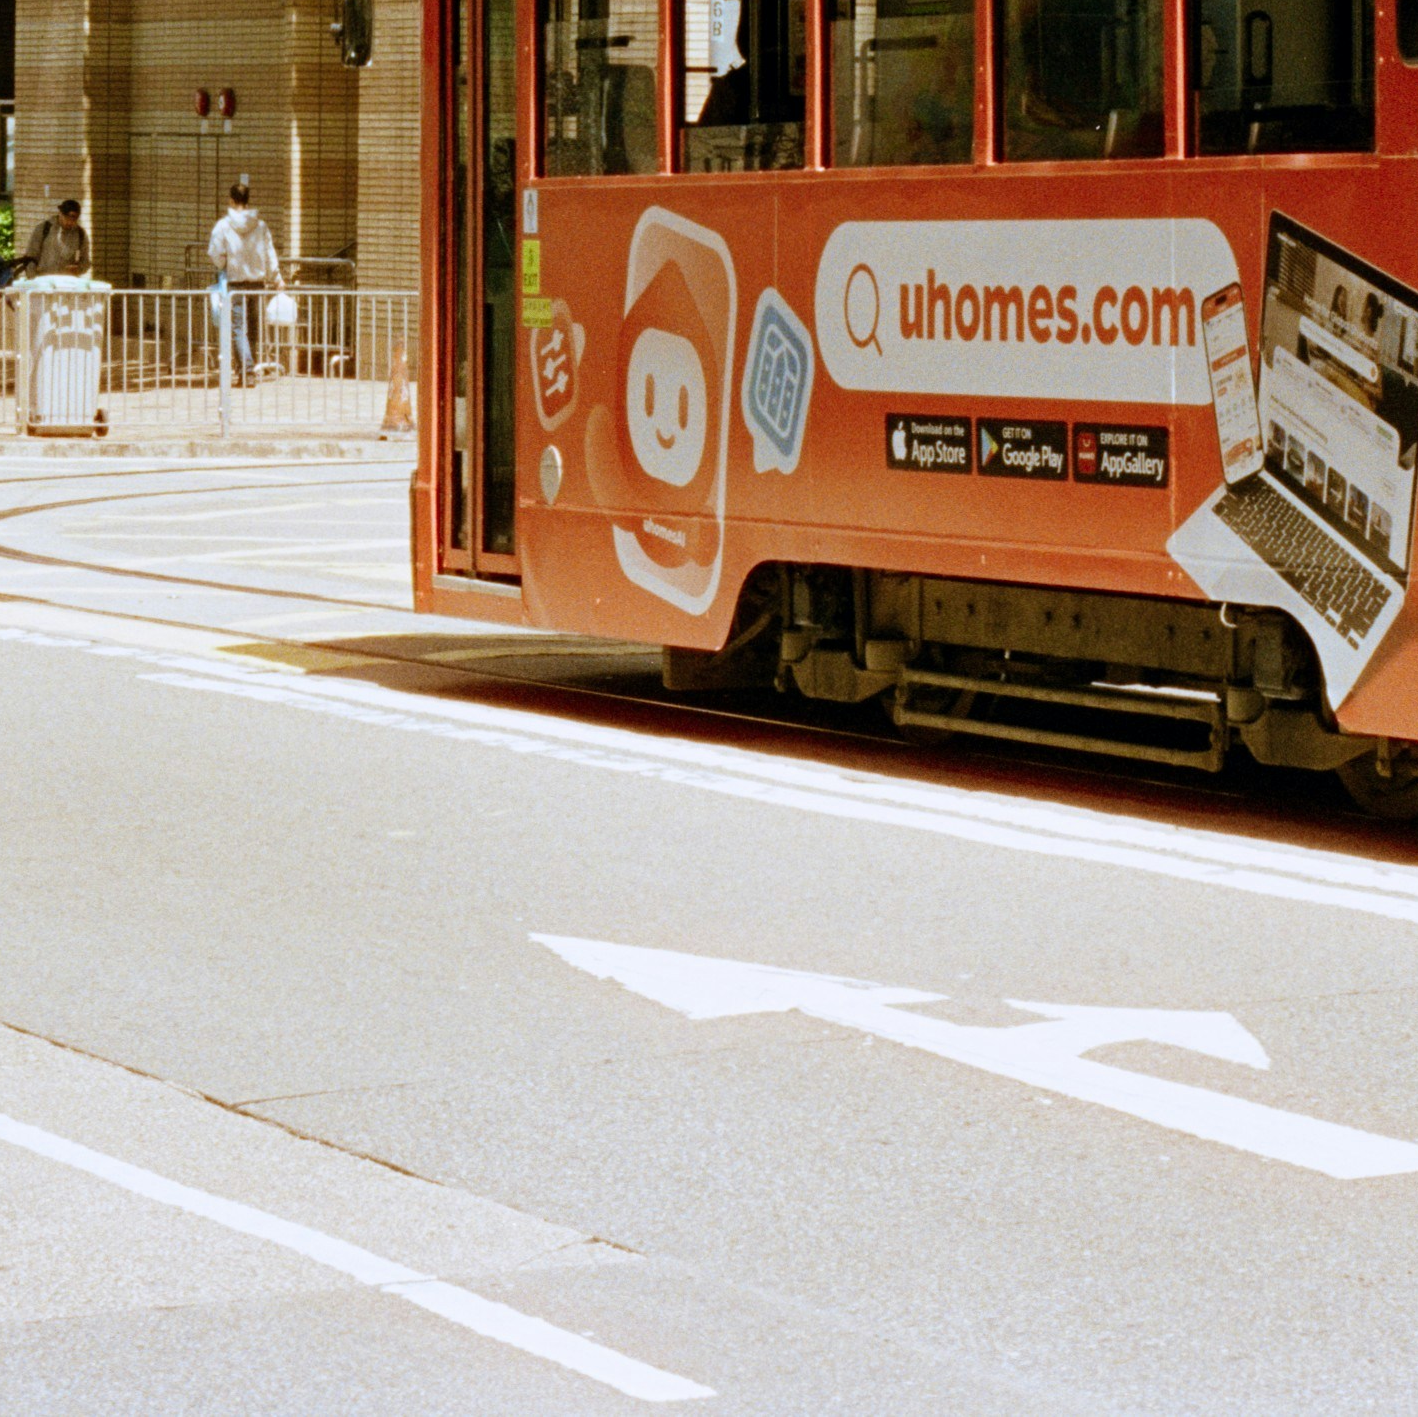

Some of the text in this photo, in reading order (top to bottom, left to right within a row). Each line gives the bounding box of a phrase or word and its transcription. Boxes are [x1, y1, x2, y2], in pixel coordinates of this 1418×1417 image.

[899, 269, 1196, 348] uhomes.com
[911, 422, 965, 437] Download on the
[1002, 427, 1032, 440] GET IT ON
[1100, 433, 1149, 447] EXPLORE IT ON
[911, 440, 966, 464] App Store
[1003, 443, 1064, 473] Google Play
[1101, 452, 1164, 481] AppGallery
